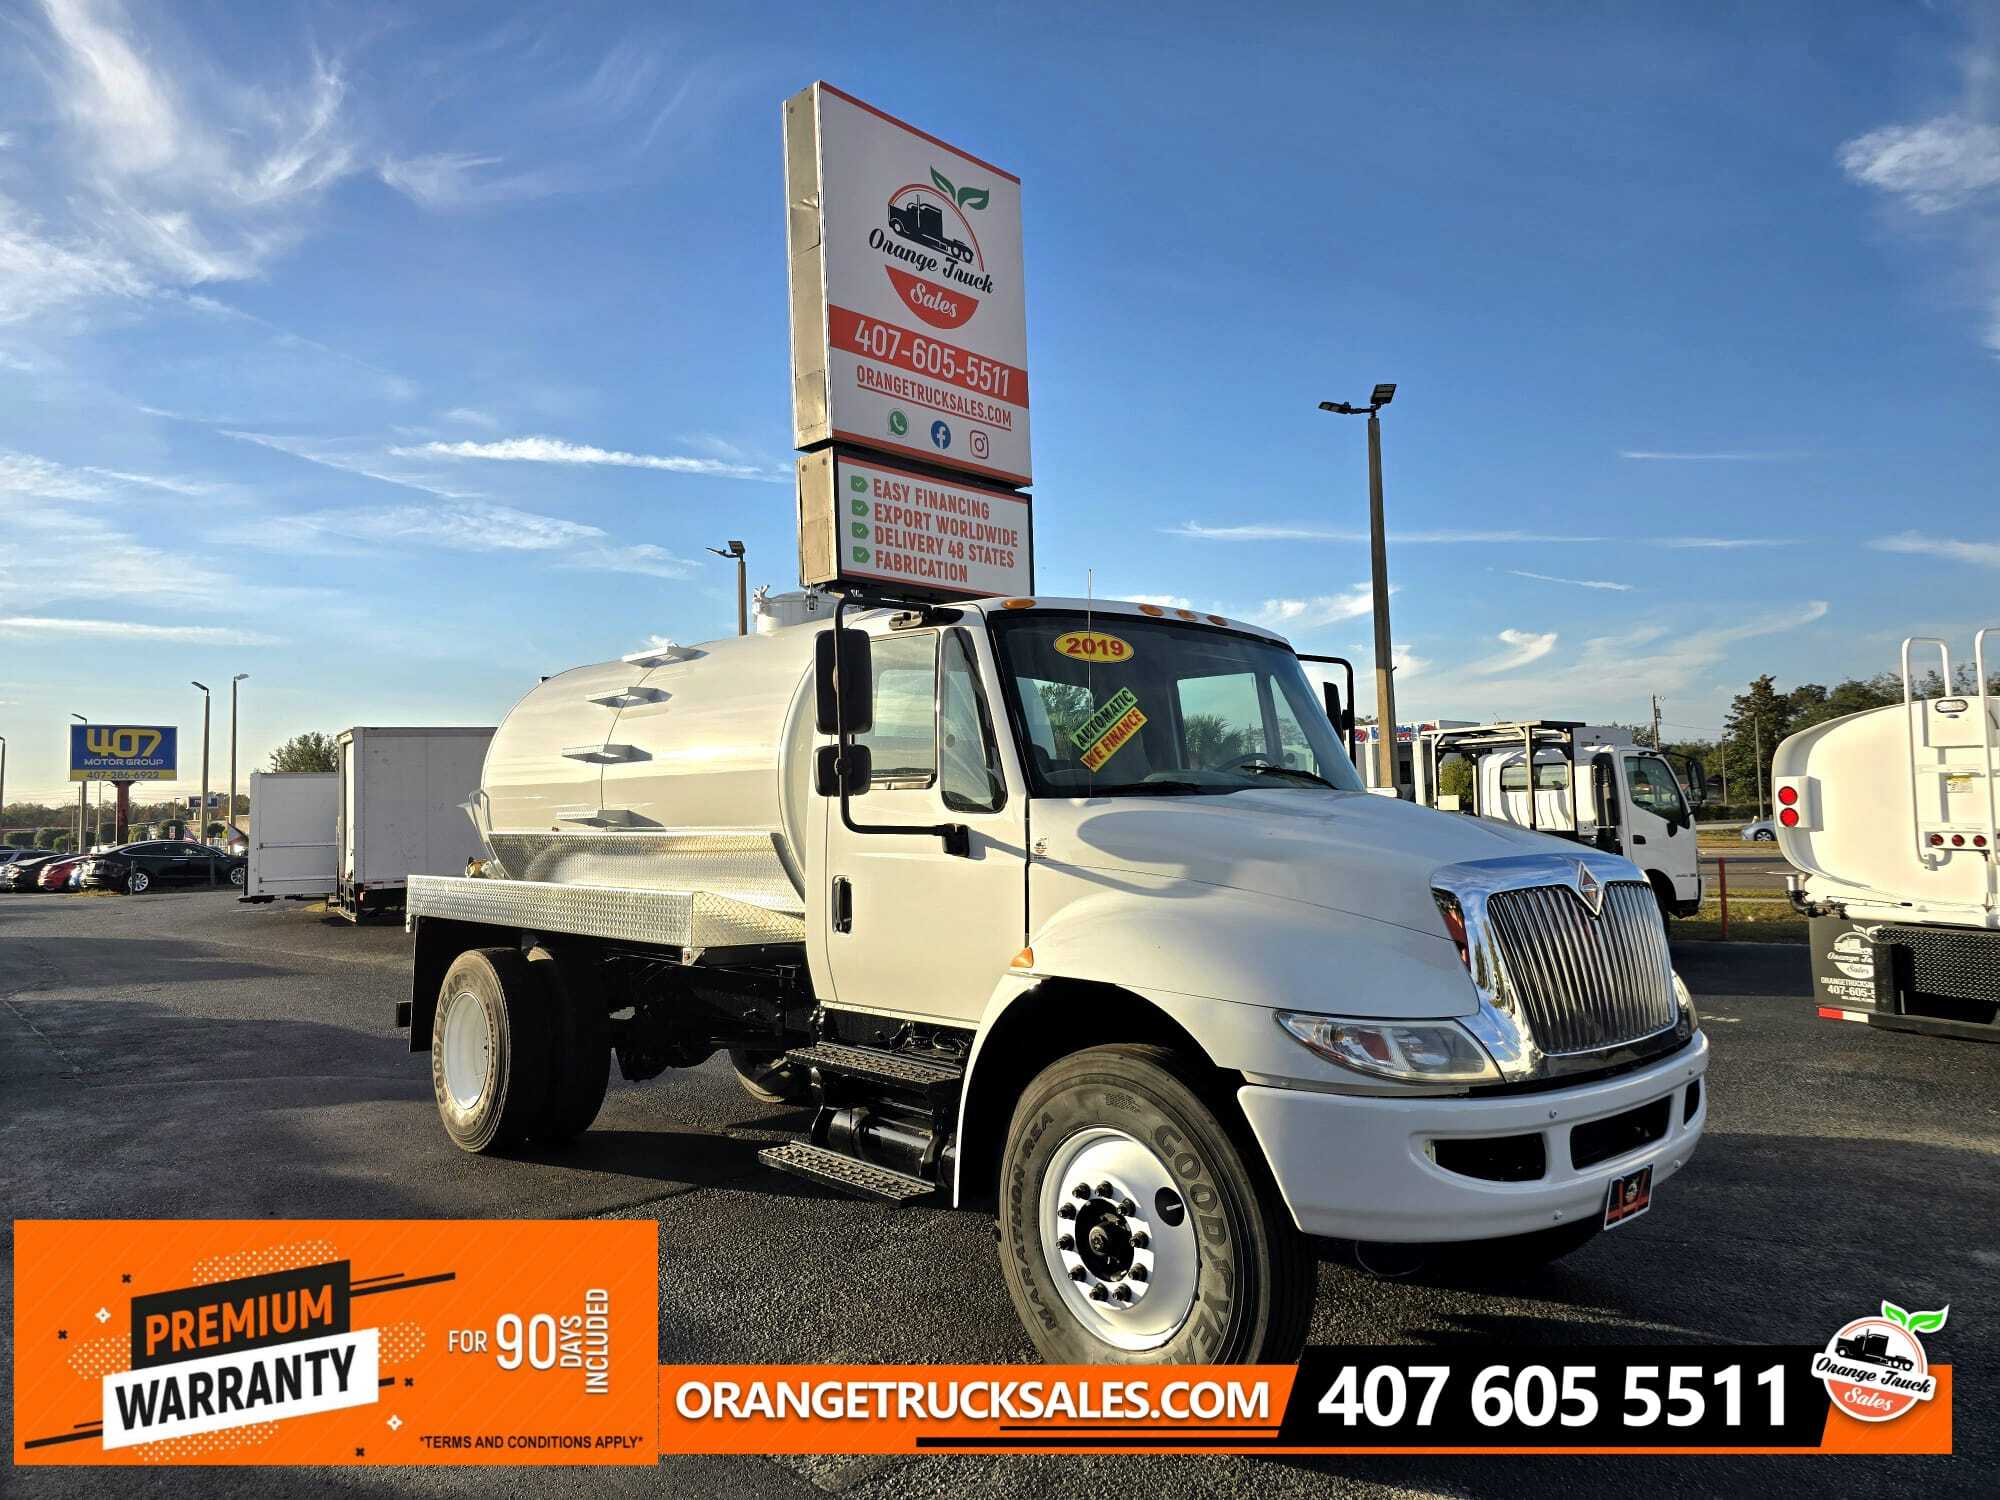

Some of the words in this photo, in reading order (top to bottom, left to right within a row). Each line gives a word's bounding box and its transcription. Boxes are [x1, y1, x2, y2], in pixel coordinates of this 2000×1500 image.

[868, 228, 938, 272] Orange
[942, 259, 994, 294] Truck
[910, 282, 958, 319] Sales
[854, 319, 1010, 397] 407-605-5511
[856, 364, 1012, 427] ORANGETRUCKSALES.COM
[873, 478, 910, 503] EASY
[915, 487, 990, 520] FINANCING
[874, 502, 932, 531] EXPORT
[935, 515, 1018, 548] WORLDWIDE
[874, 525, 944, 556] DELIVERY
[947, 541, 964, 558] 48
[968, 545, 1015, 568] STATES
[875, 550, 968, 582] FABRICATION
[1065, 637, 1124, 657] 2019
[1076, 690, 1134, 747] AUTOMATIC
[1083, 745, 1105, 769] WE
[1102, 709, 1143, 753] FINANCE
[84, 758, 124, 766] MOTOR
[126, 758, 164, 766] GROUP
[86, 728, 162, 758] 407
